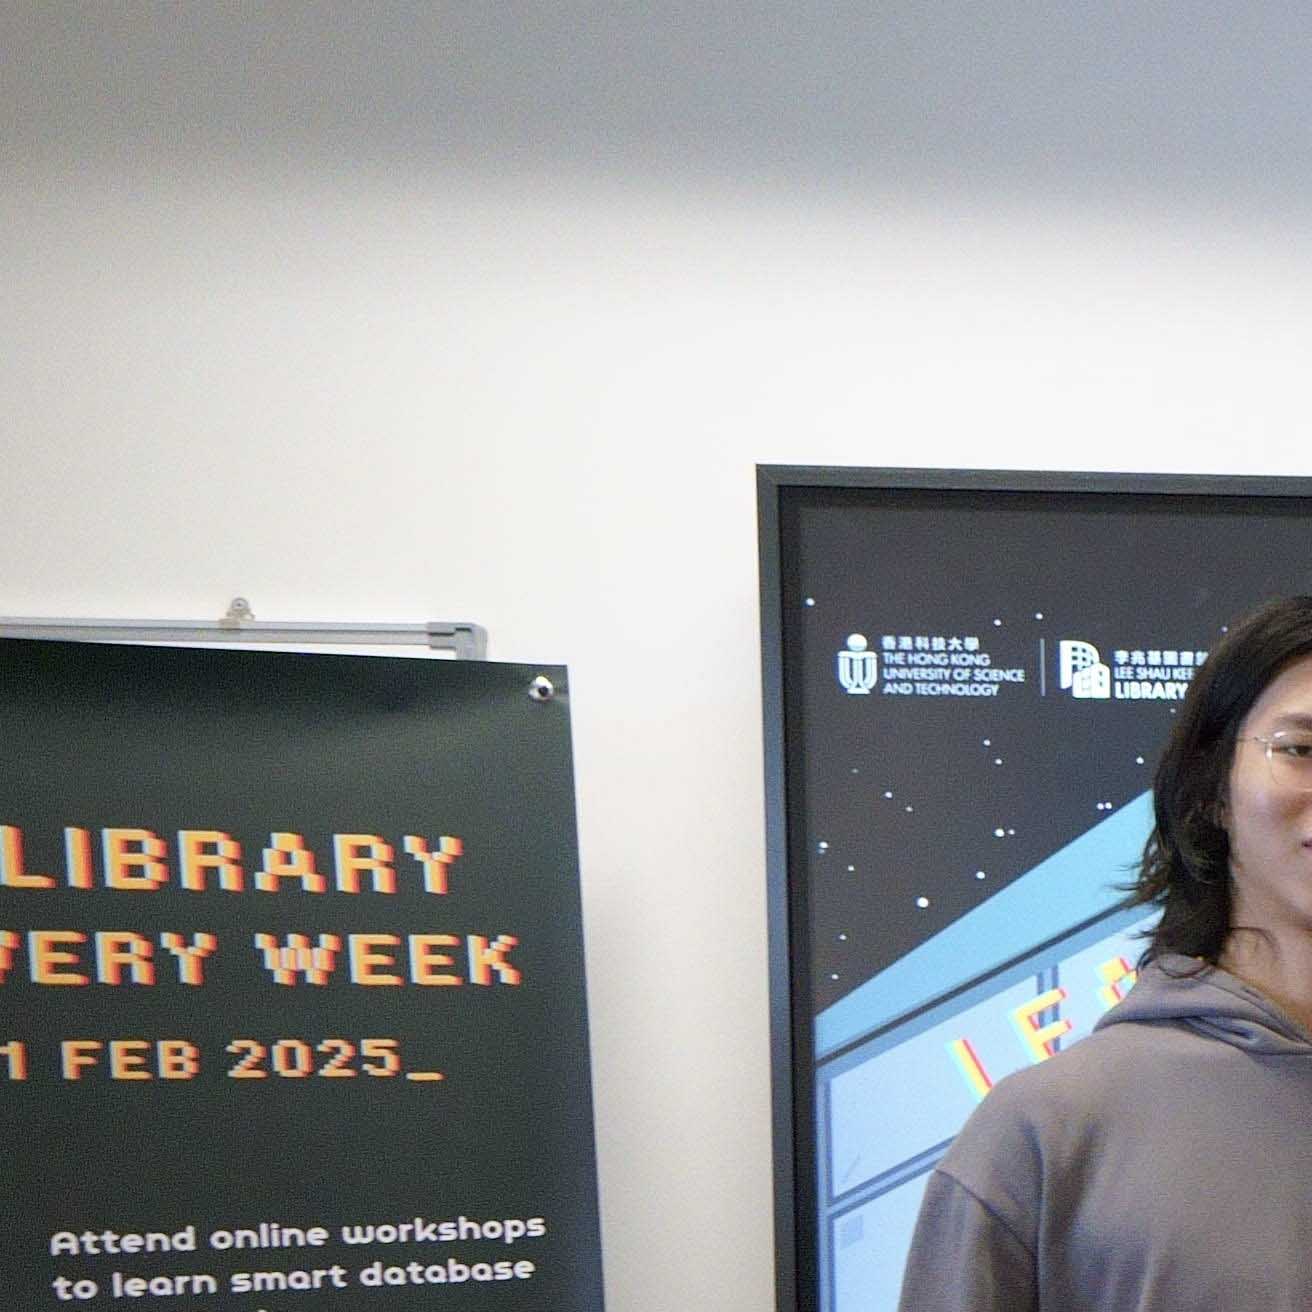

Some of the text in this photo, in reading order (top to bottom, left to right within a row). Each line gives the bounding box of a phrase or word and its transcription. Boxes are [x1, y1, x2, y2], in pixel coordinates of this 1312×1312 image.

[883, 653, 991, 667] THE HONG KONG
[883, 668, 1025, 682] UNIVERSITY OF SCIENCE
[1114, 666, 1134, 680] LEE
[1136, 667, 1171, 680] SHAU
[883, 683, 999, 697] AND TECHNOLOGY
[1114, 681, 1188, 700] LIBRARY
[0, 824, 464, 894] LIBRARY
[254, 932, 522, 986] WEEK
[61, 1039, 200, 1081] FEB
[49, 1213, 547, 1257] Attend online workshops
[52, 1256, 535, 1301] to learn smart database
